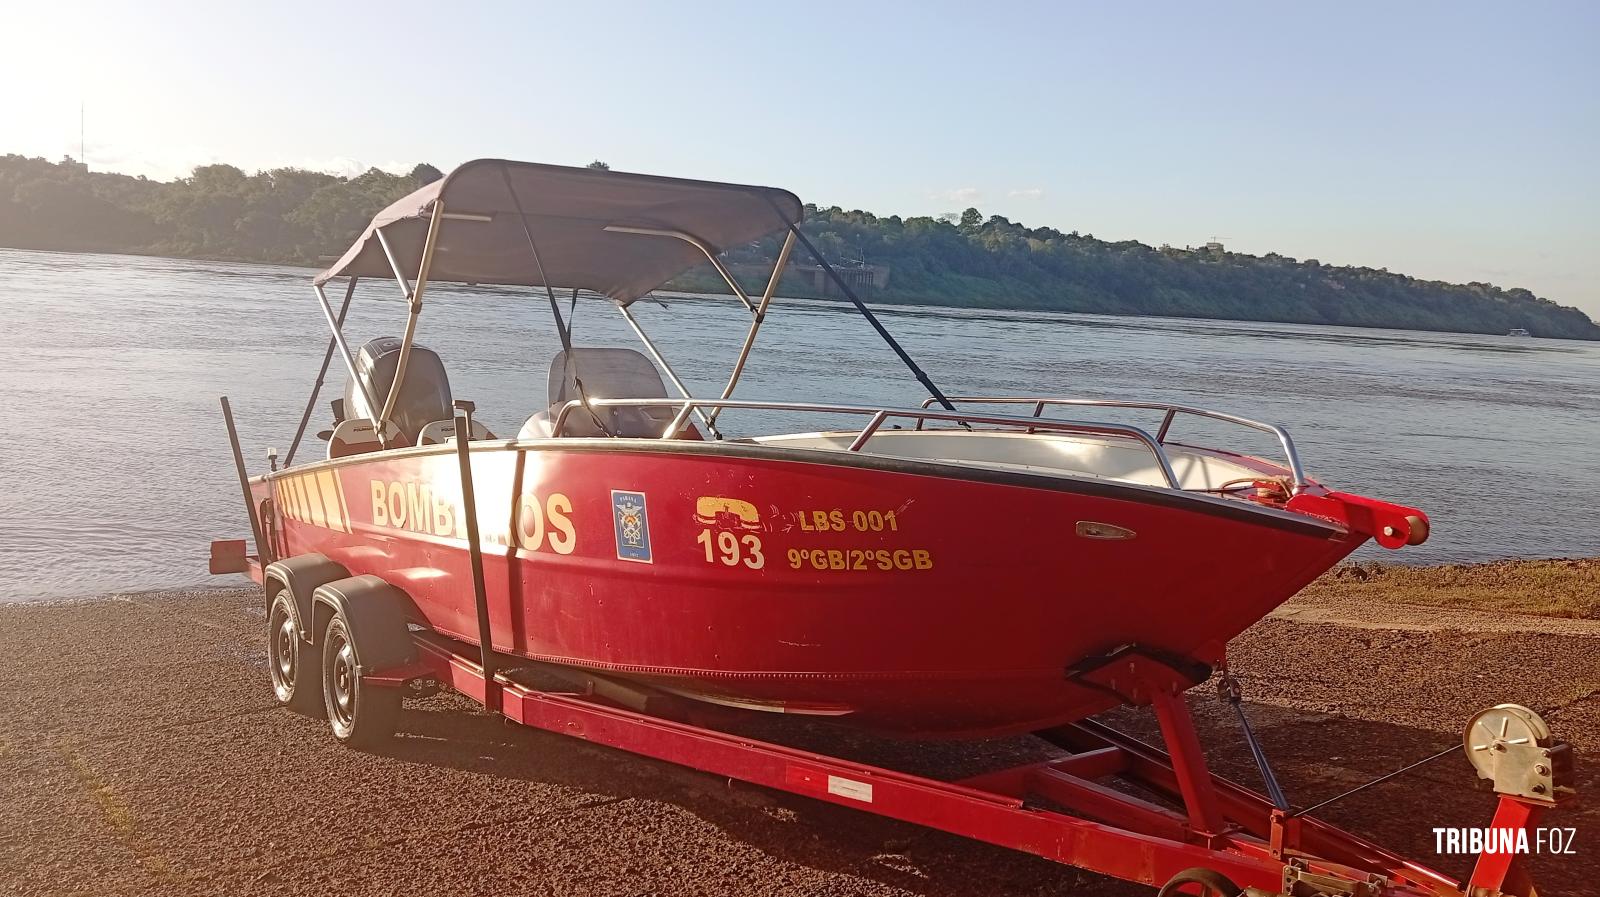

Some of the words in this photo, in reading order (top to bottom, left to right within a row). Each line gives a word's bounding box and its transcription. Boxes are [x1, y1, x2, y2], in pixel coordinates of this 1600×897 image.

[799, 510, 846, 531] LBS
[852, 510, 898, 531] 001
[697, 529, 765, 569] 193
